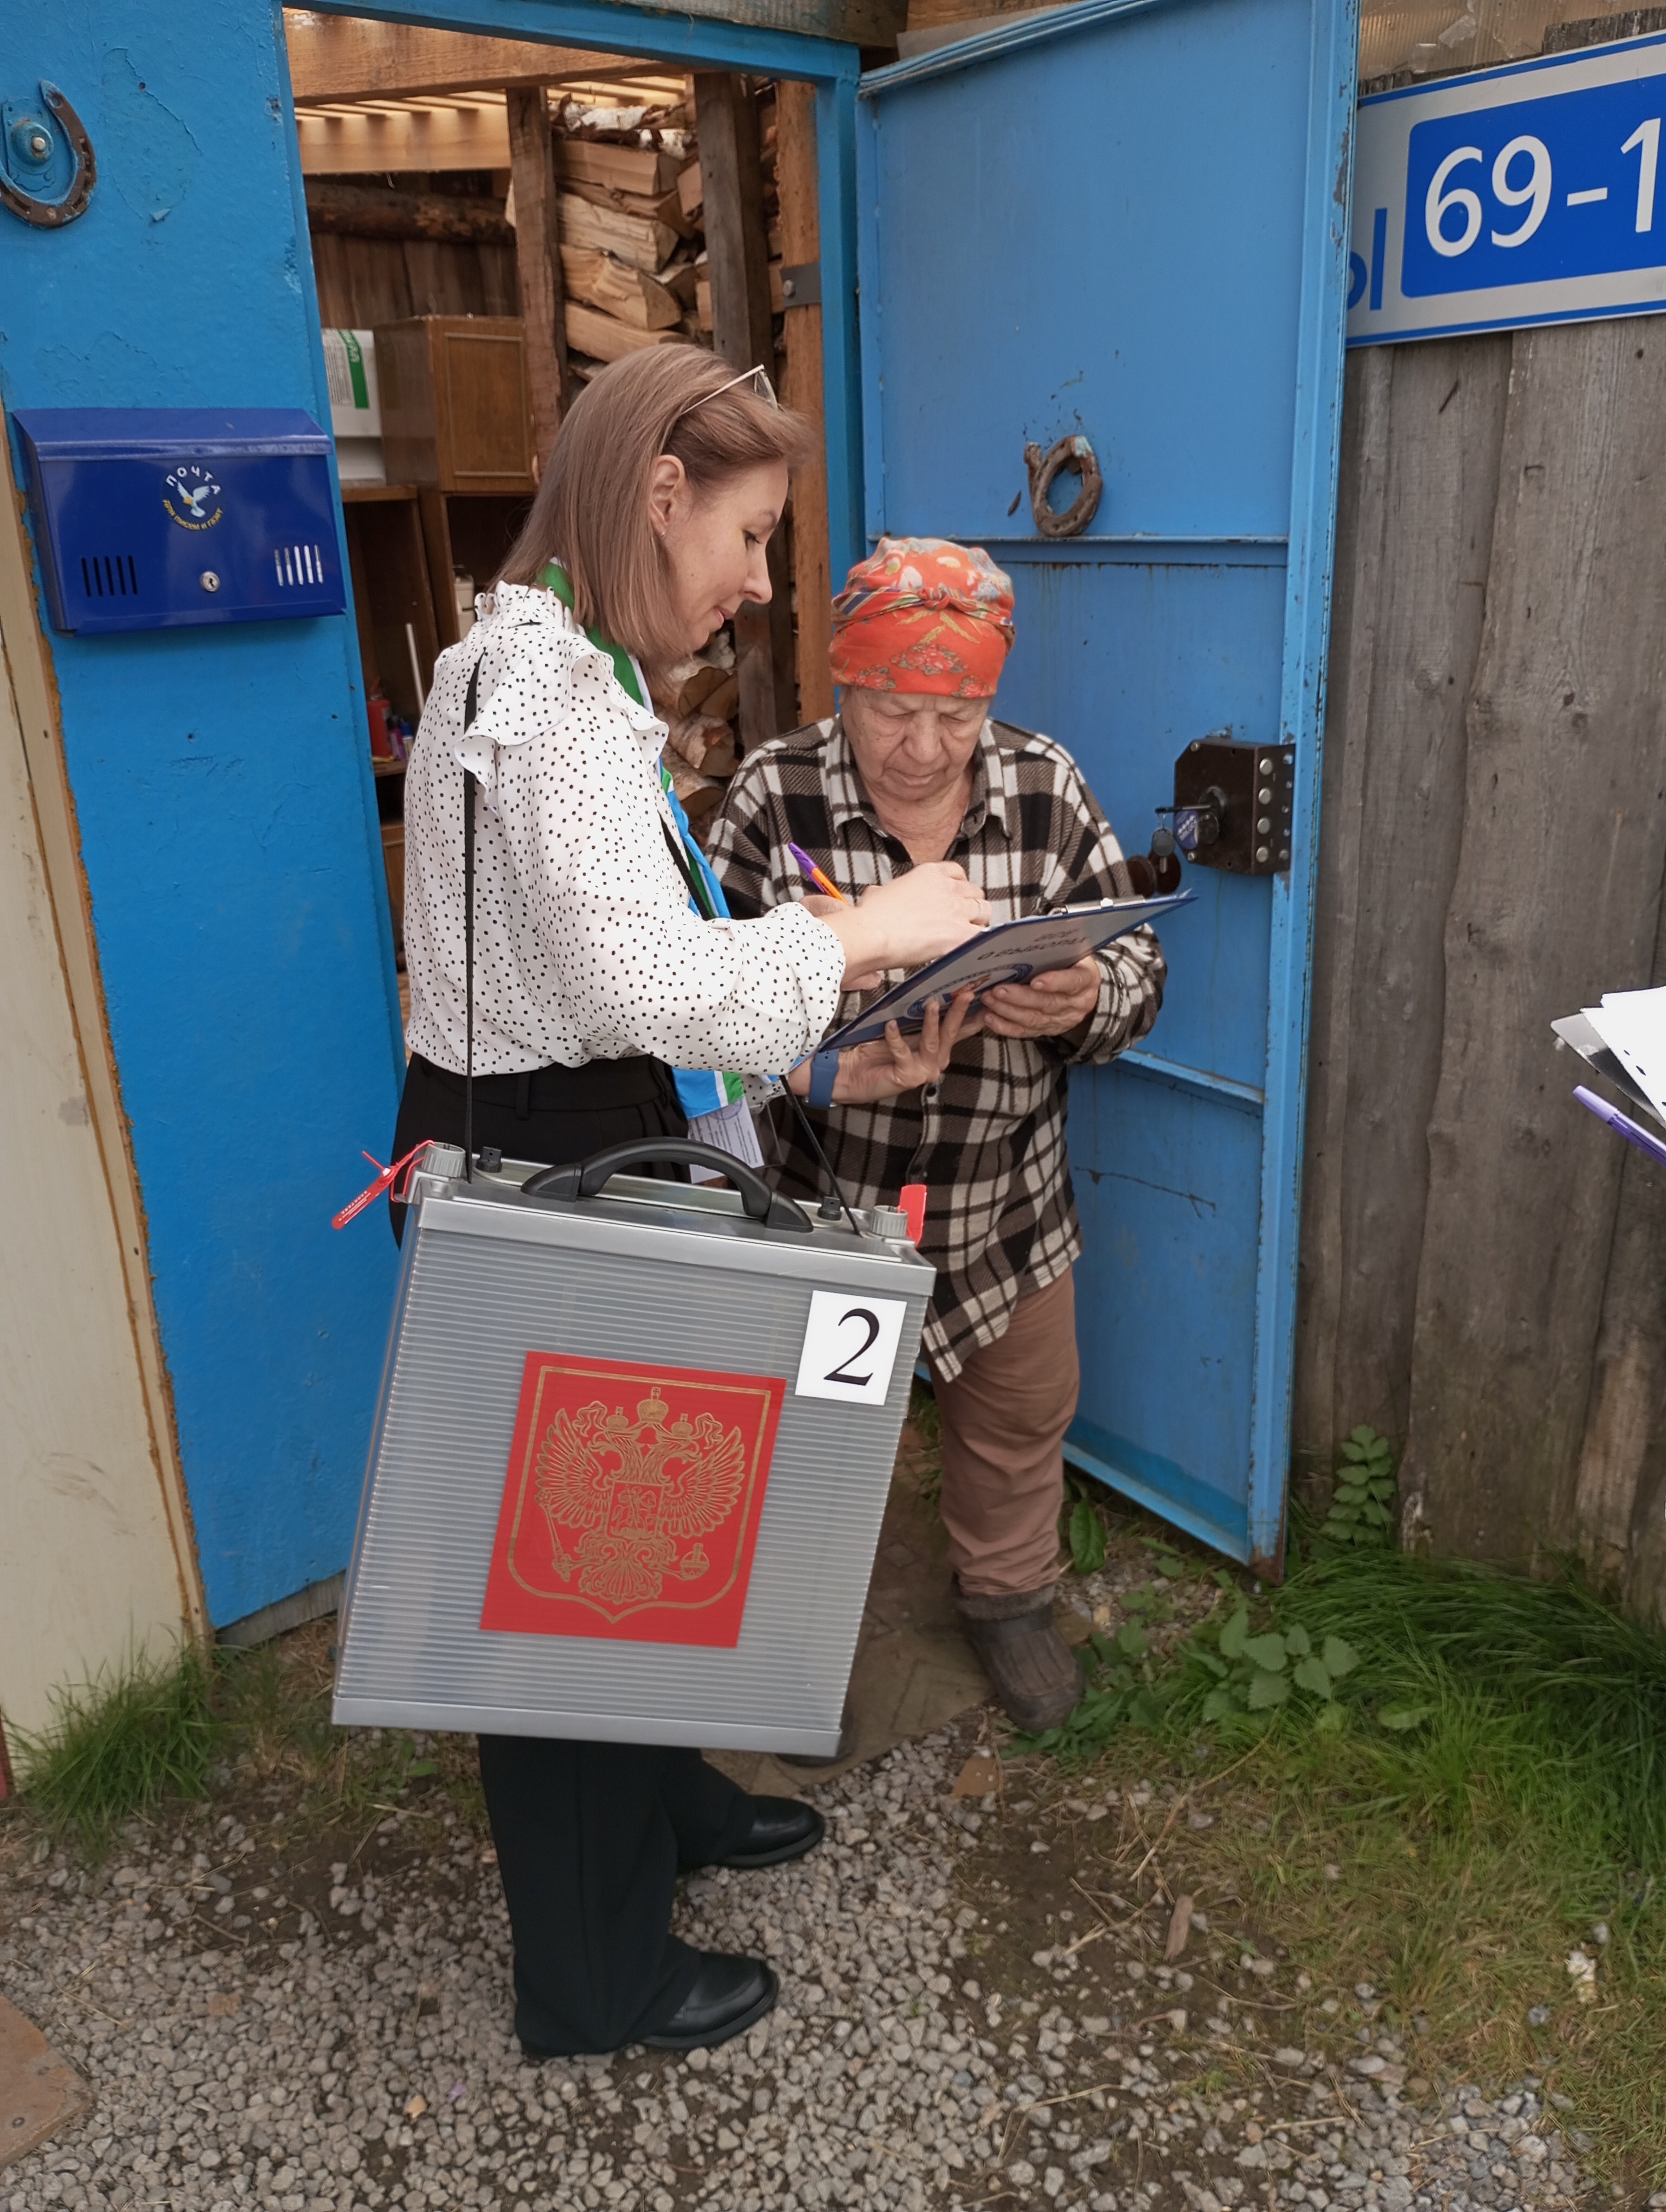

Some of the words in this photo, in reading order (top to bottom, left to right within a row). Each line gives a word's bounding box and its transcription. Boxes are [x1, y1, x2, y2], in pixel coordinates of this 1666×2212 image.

[1425, 117, 1661, 258] 69-1
[165, 466, 221, 495] ПОЧТА
[823, 1308, 880, 1386] 2
